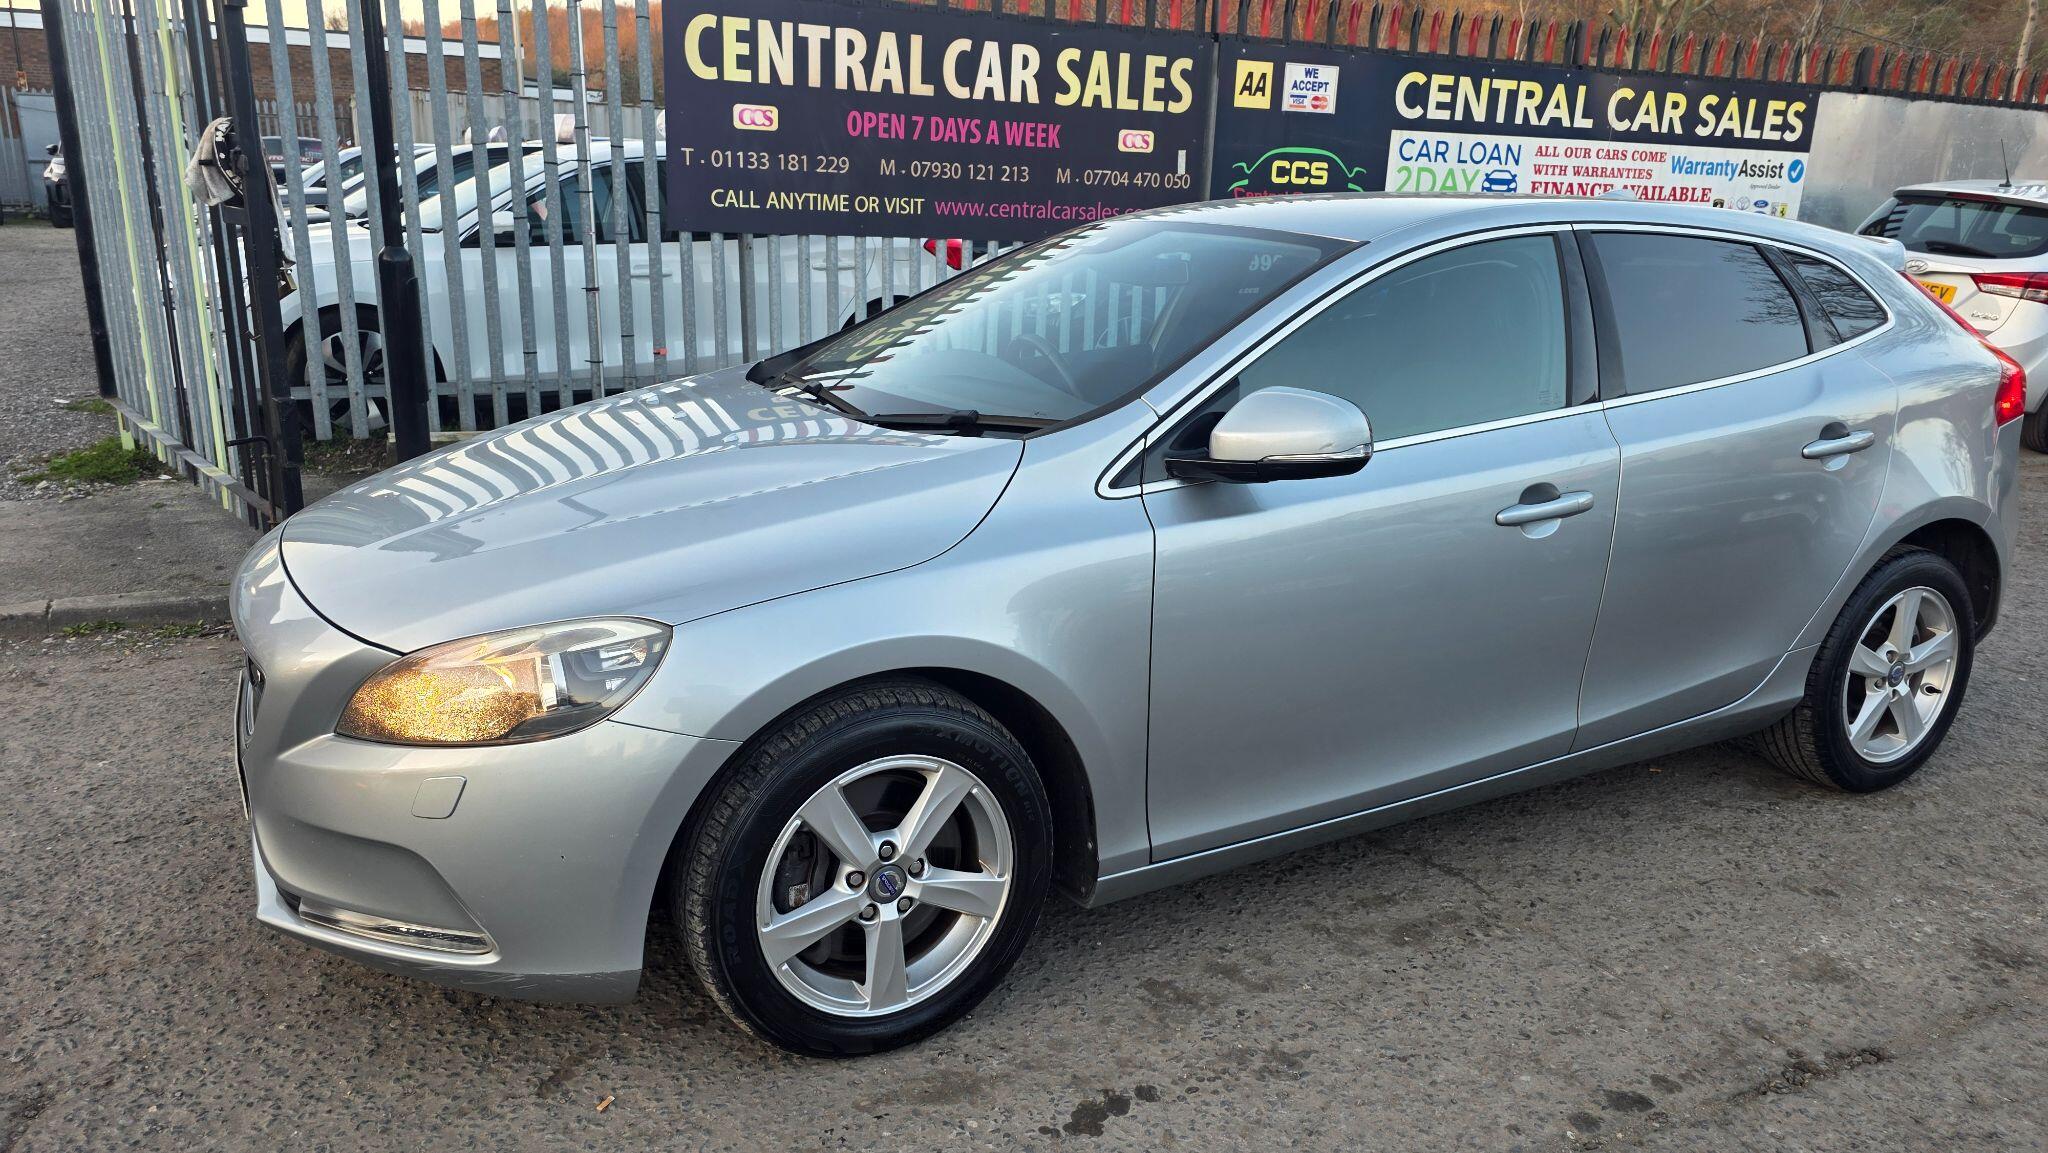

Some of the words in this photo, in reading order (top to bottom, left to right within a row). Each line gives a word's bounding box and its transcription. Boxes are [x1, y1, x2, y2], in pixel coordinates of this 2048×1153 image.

[684, 13, 935, 97] CENTRAL
[943, 38, 1041, 104] CAR
[1054, 48, 1194, 114] SALES
[1304, 67, 1320, 79] WE
[1239, 71, 1267, 97] AA
[1291, 80, 1330, 92] ACCEPT
[738, 107, 775, 128] CCS
[1395, 71, 1594, 129] CENTRAL
[1607, 87, 1687, 135] CAR
[1694, 94, 1807, 143] SALES
[847, 110, 905, 142] OPEN
[911, 115, 925, 141] 7
[931, 117, 982, 144] DAYS
[986, 120, 1000, 145] A
[1005, 121, 1062, 149] WEEK
[711, 150, 770, 170] 01133
[778, 153, 808, 172] 181
[816, 155, 850, 174] 229
[1398, 138, 1450, 163] CAR
[1457, 141, 1522, 166] LOAN
[1534, 145, 1560, 158] ALL
[1564, 147, 1592, 160] OUR
[1595, 148, 1628, 161] CARS
[1631, 150, 1668, 163] COME
[911, 161, 962, 180] 07930
[968, 164, 994, 181] 121
[1001, 165, 1030, 182] 213
[1084, 170, 1129, 187] 07704
[1133, 172, 1160, 188] 470
[1164, 173, 1191, 189] 050
[1271, 160, 1329, 185] CCS
[1396, 165, 1481, 192] 2DAY
[1533, 163, 1568, 177] WITH
[1572, 165, 1653, 180] WARRANTIES
[710, 189, 760, 209] CALL
[766, 191, 850, 212] ANYTIME
[855, 196, 880, 213] OR
[884, 197, 925, 215] VISIT
[1530, 181, 1614, 197] FINANCE
[1622, 184, 1712, 203] VAILABLE
